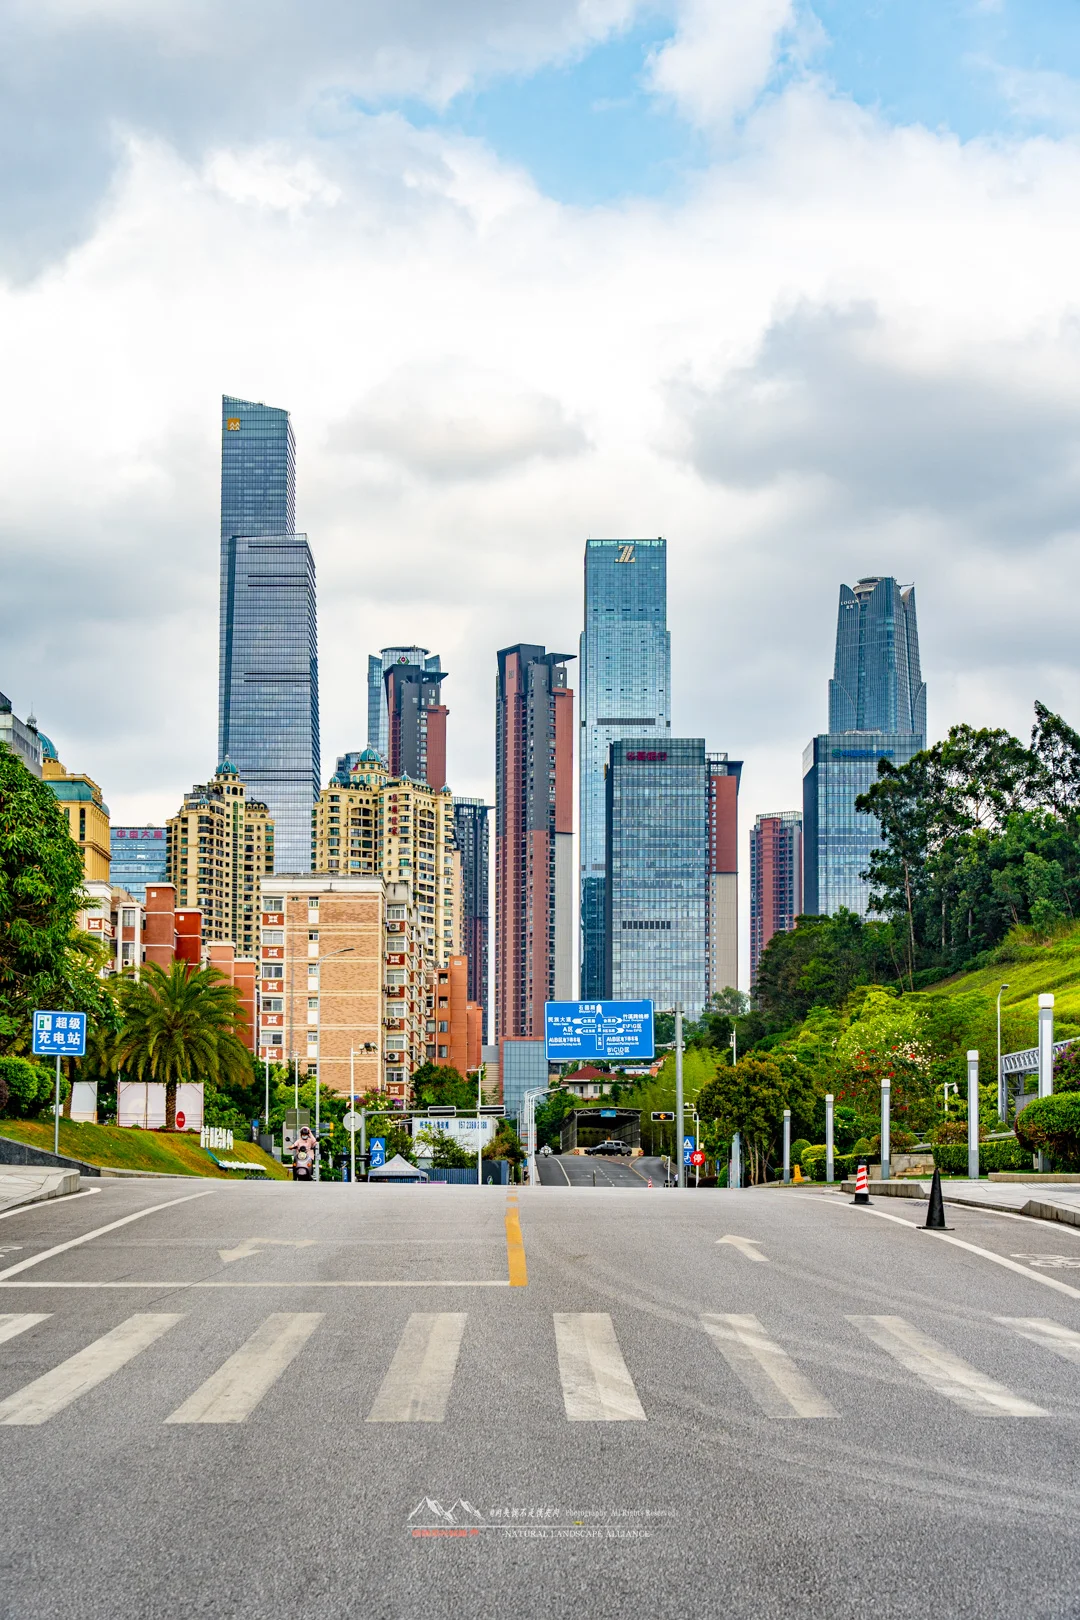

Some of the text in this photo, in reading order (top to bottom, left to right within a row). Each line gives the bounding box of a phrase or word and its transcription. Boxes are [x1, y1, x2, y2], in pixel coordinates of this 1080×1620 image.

[55, 1016, 81, 1030] 超级
[37, 1031, 81, 1045] 充电站
